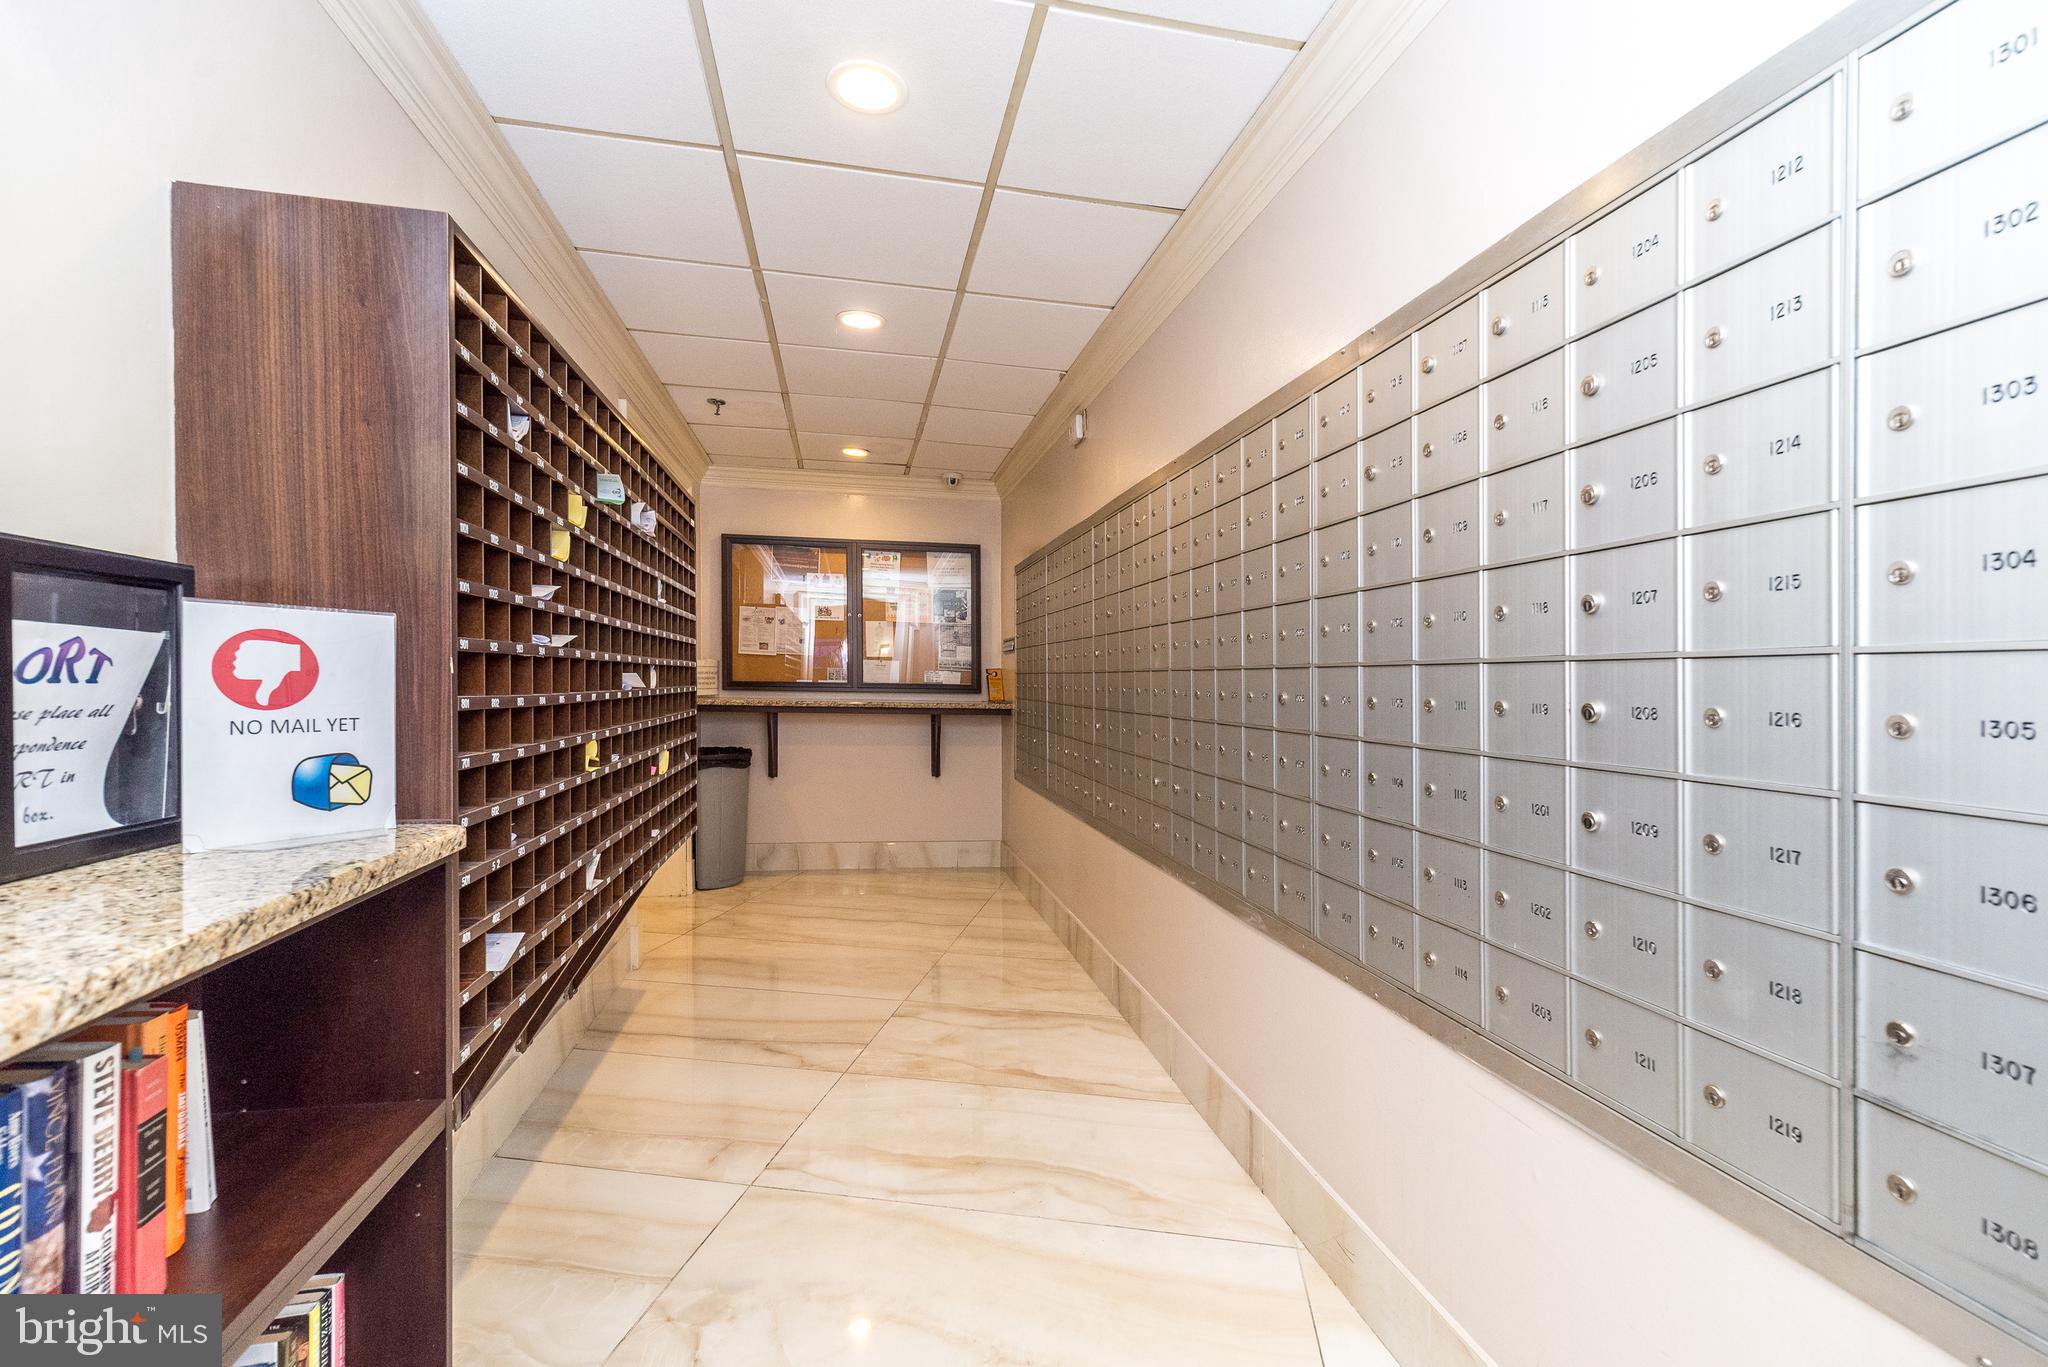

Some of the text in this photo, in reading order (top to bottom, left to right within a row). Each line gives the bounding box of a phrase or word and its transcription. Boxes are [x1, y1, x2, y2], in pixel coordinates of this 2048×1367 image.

[1989, 27, 2038, 67] 1301
[1771, 155, 1804, 185] 1212
[1984, 201, 2039, 238] 1302
[1632, 234, 1659, 258] 1204
[1770, 295, 1803, 321] 1213
[1631, 353, 1658, 376] 1205
[1983, 375, 2038, 405] 1303
[1769, 434, 1801, 456] 1214
[1631, 472, 1658, 490] 1206
[1531, 500, 1548, 514] 1117
[1982, 549, 2037, 571] 1304
[1768, 573, 1801, 592] 1215
[1631, 589, 1658, 605] 1207
[1531, 602, 1549, 614] 1118
[459, 639, 469, 650] 901
[13, 636, 114, 685] ORT
[461, 698, 470, 709] 801
[491, 698, 500, 708] 802
[1531, 703, 1549, 715] 1119
[35, 704, 82, 726] place
[88, 703, 114, 719] all
[1631, 706, 1658, 721] 1208
[1768, 711, 1802, 727] 1216
[230, 717, 360, 735] NO MAIL YET
[1980, 720, 2036, 740] 1305
[461, 757, 471, 769] 701
[491, 752, 500, 763] 702
[61, 770, 76, 784] in
[1454, 788, 1468, 801] 1112
[22, 806, 53, 824] box.
[491, 805, 500, 817] 602
[1531, 802, 1550, 817] 1201
[1631, 821, 1658, 838] 1209
[1769, 846, 1801, 866] 1217
[461, 873, 471, 887] 501
[1454, 877, 1468, 891] 1113
[1980, 886, 2037, 913] 1306
[1530, 902, 1552, 920] 1202
[1632, 935, 1657, 955] 1210
[1454, 966, 1468, 981] 1114
[1769, 981, 1802, 1005] 1218
[1531, 1002, 1552, 1022] 1203
[175, 1022, 186, 1062] OSMAN
[1635, 1051, 1656, 1072] 1211
[1981, 1052, 2036, 1085] 1307
[93, 1053, 115, 1199] STEVE BERRY
[1769, 1115, 1802, 1143] 1219
[44, 1077, 66, 1226] VINCE FLYNN
[1981, 1218, 2038, 1260] 1308
